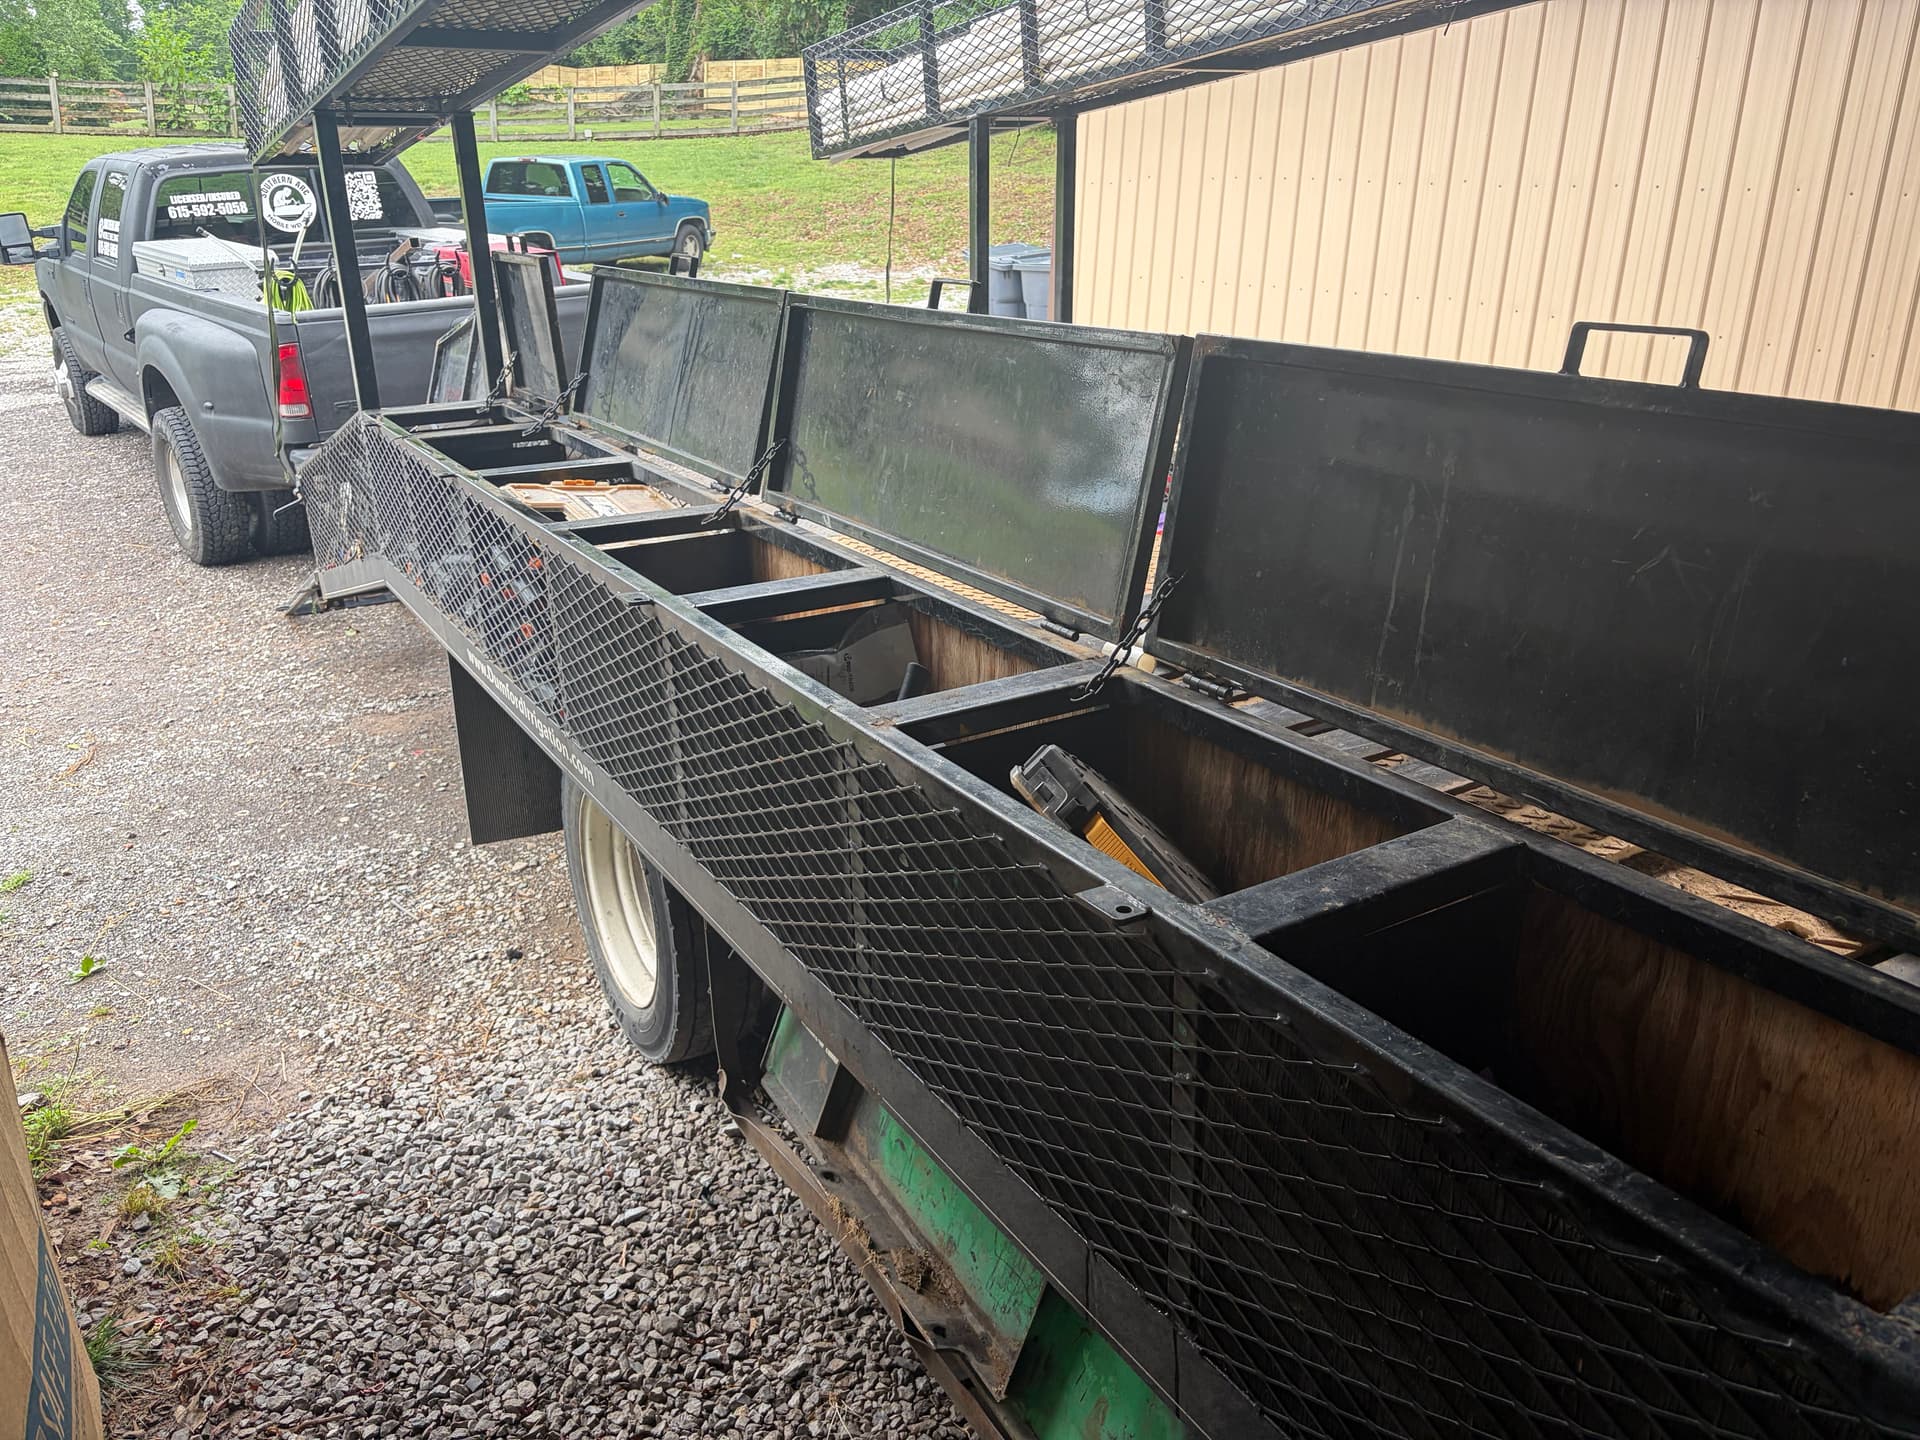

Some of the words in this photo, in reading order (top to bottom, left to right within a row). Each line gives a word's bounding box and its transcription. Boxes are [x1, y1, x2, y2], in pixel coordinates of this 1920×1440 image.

[261, 175, 293, 199] SOUTHERN
[294, 181, 310, 196] ARC
[169, 191, 242, 205] LICENSED/INSURED
[167, 201, 248, 219] 615-592-5058
[266, 213, 289, 229] MOBILE
